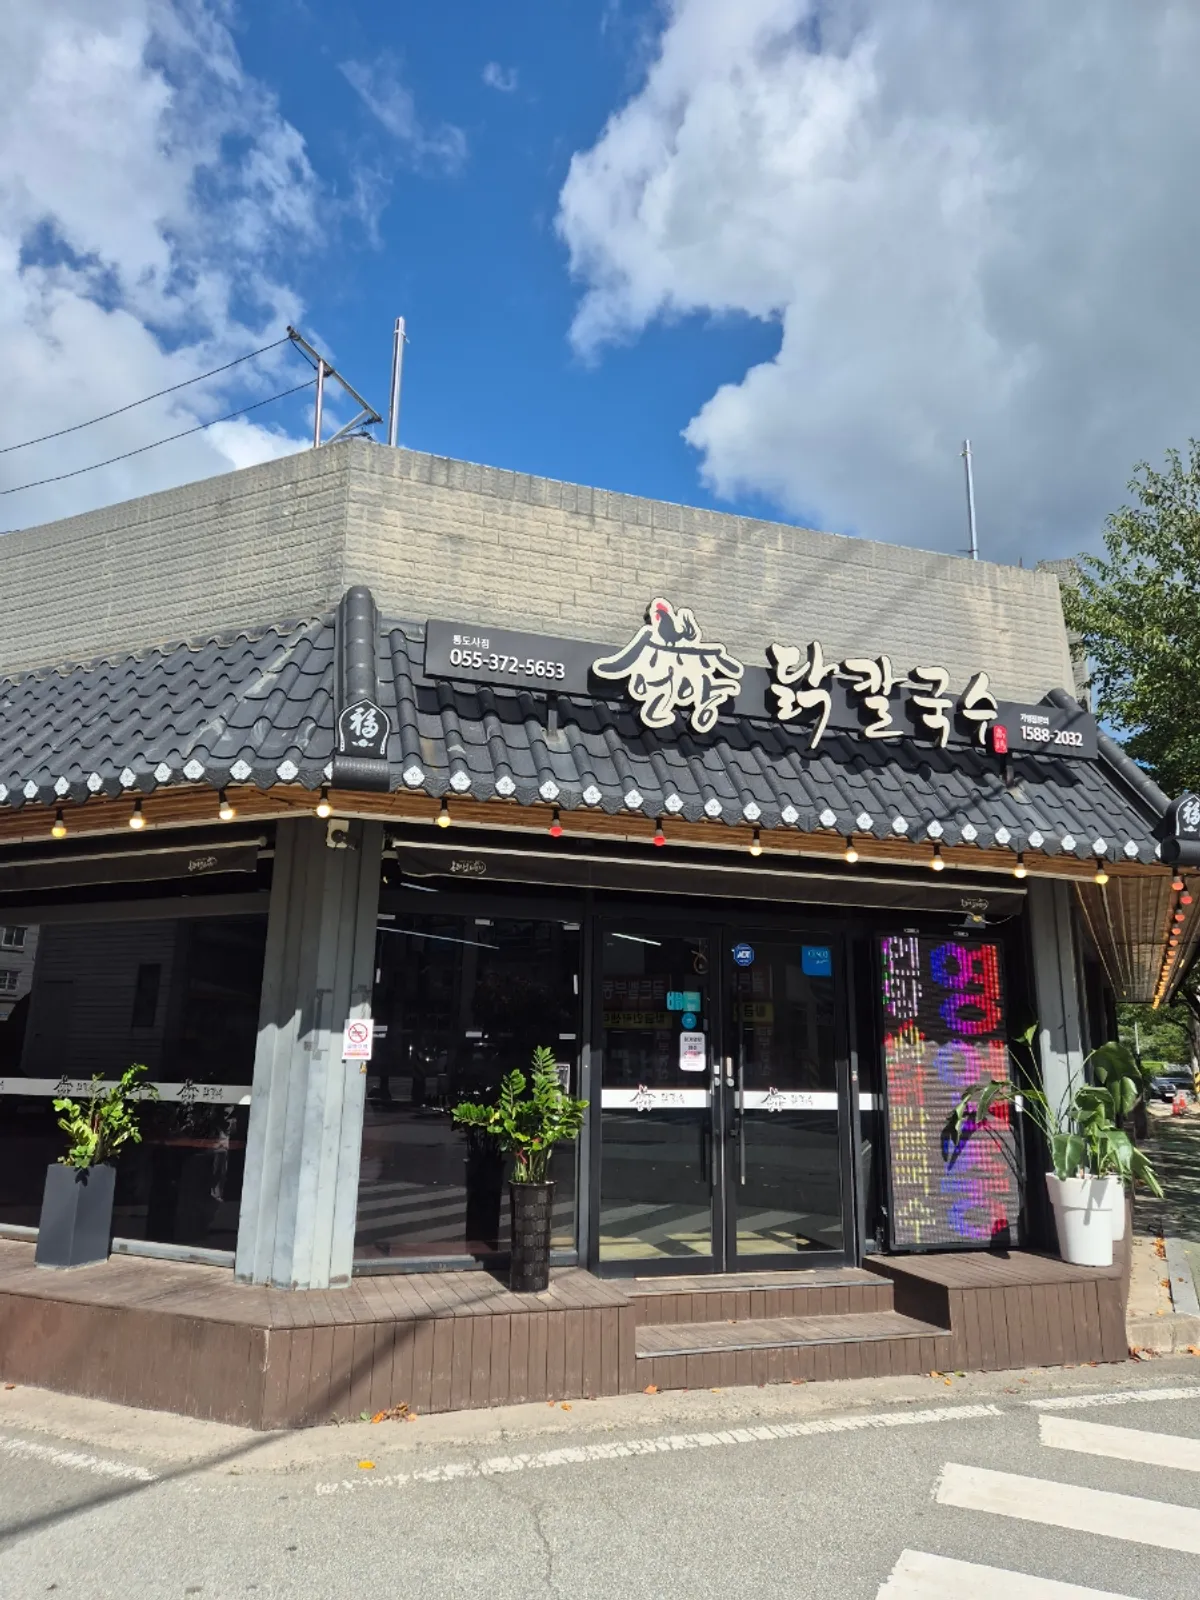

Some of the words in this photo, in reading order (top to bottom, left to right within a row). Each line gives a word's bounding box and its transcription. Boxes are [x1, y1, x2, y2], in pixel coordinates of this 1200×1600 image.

[452, 634, 491, 650] 통도사점
[449, 647, 566, 680] 055-372-5653
[767, 640, 999, 750] 닭칼국수
[1019, 724, 1084, 748] 1588-2032
